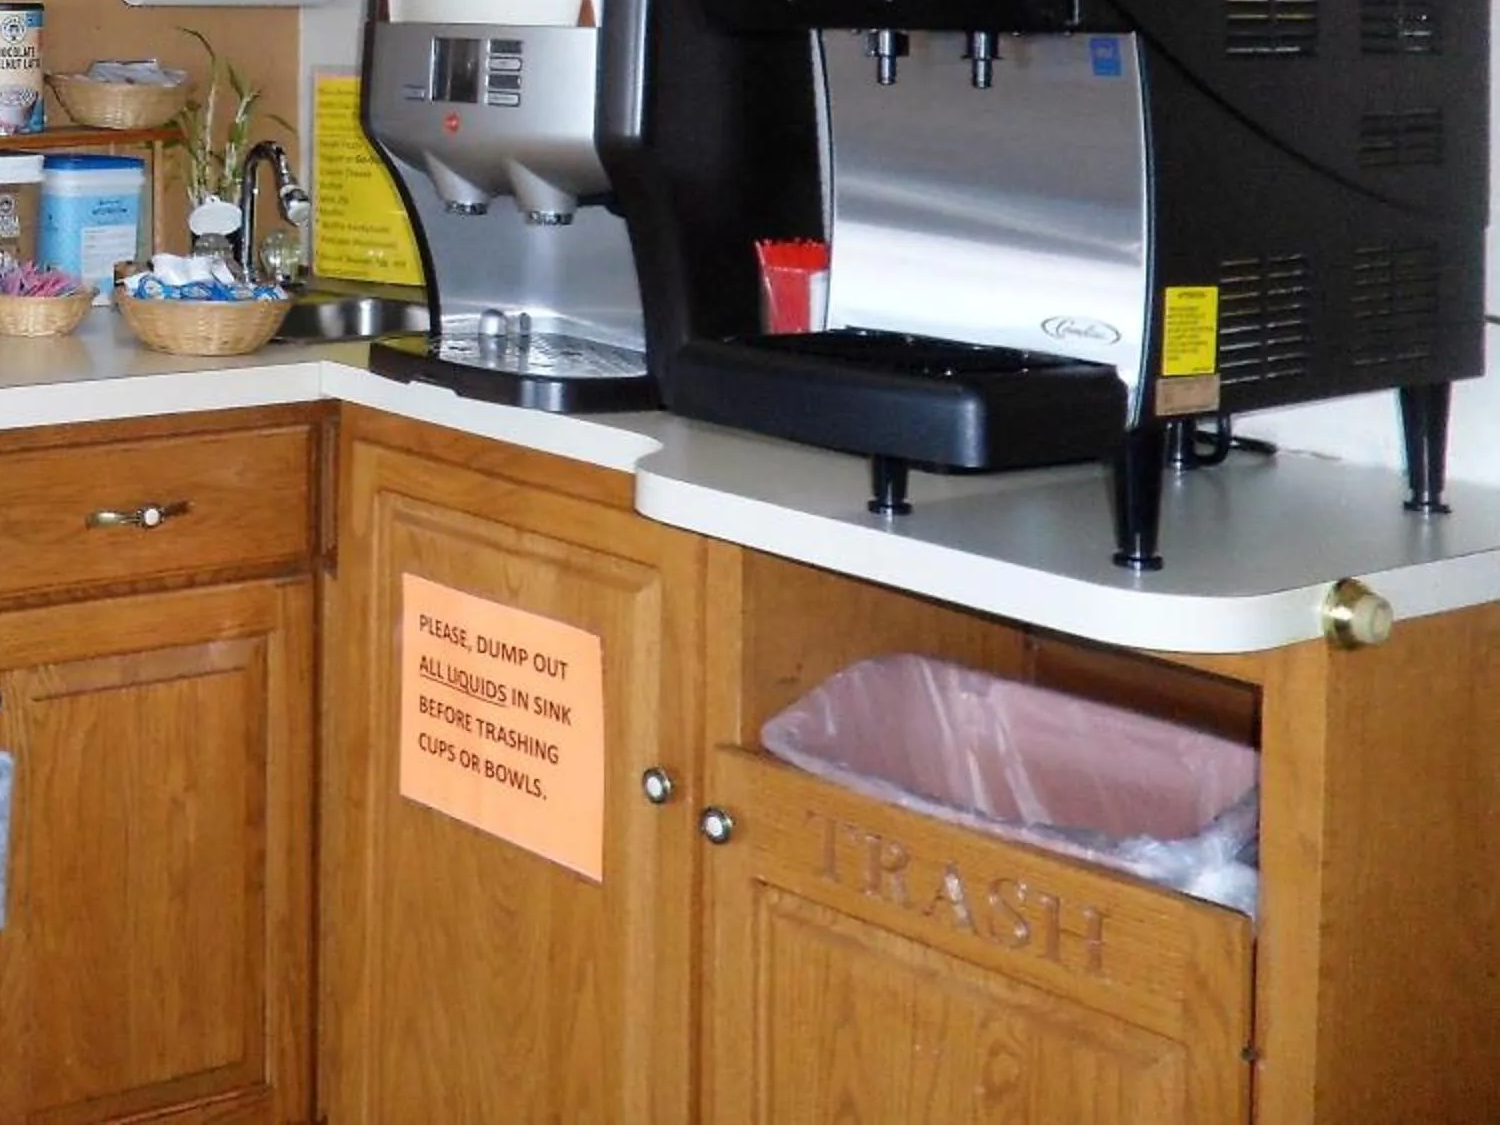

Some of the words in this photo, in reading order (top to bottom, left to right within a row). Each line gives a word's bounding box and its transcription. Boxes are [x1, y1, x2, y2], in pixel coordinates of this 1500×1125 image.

[419, 614, 472, 651] PLEASE,
[477, 636, 528, 666] DUMP
[534, 652, 568, 680] OUT
[419, 655, 444, 680] ALL
[448, 665, 507, 702] LIQUIDS
[512, 687, 528, 711] IN
[534, 696, 571, 725] SINK
[419, 695, 472, 732] BEFORE
[476, 718, 559, 765] TRASHING
[419, 732, 456, 762] CUPS
[460, 749, 480, 774] OR
[485, 760, 547, 800] BOWLS.
[804, 807, 1114, 984] TRASH
